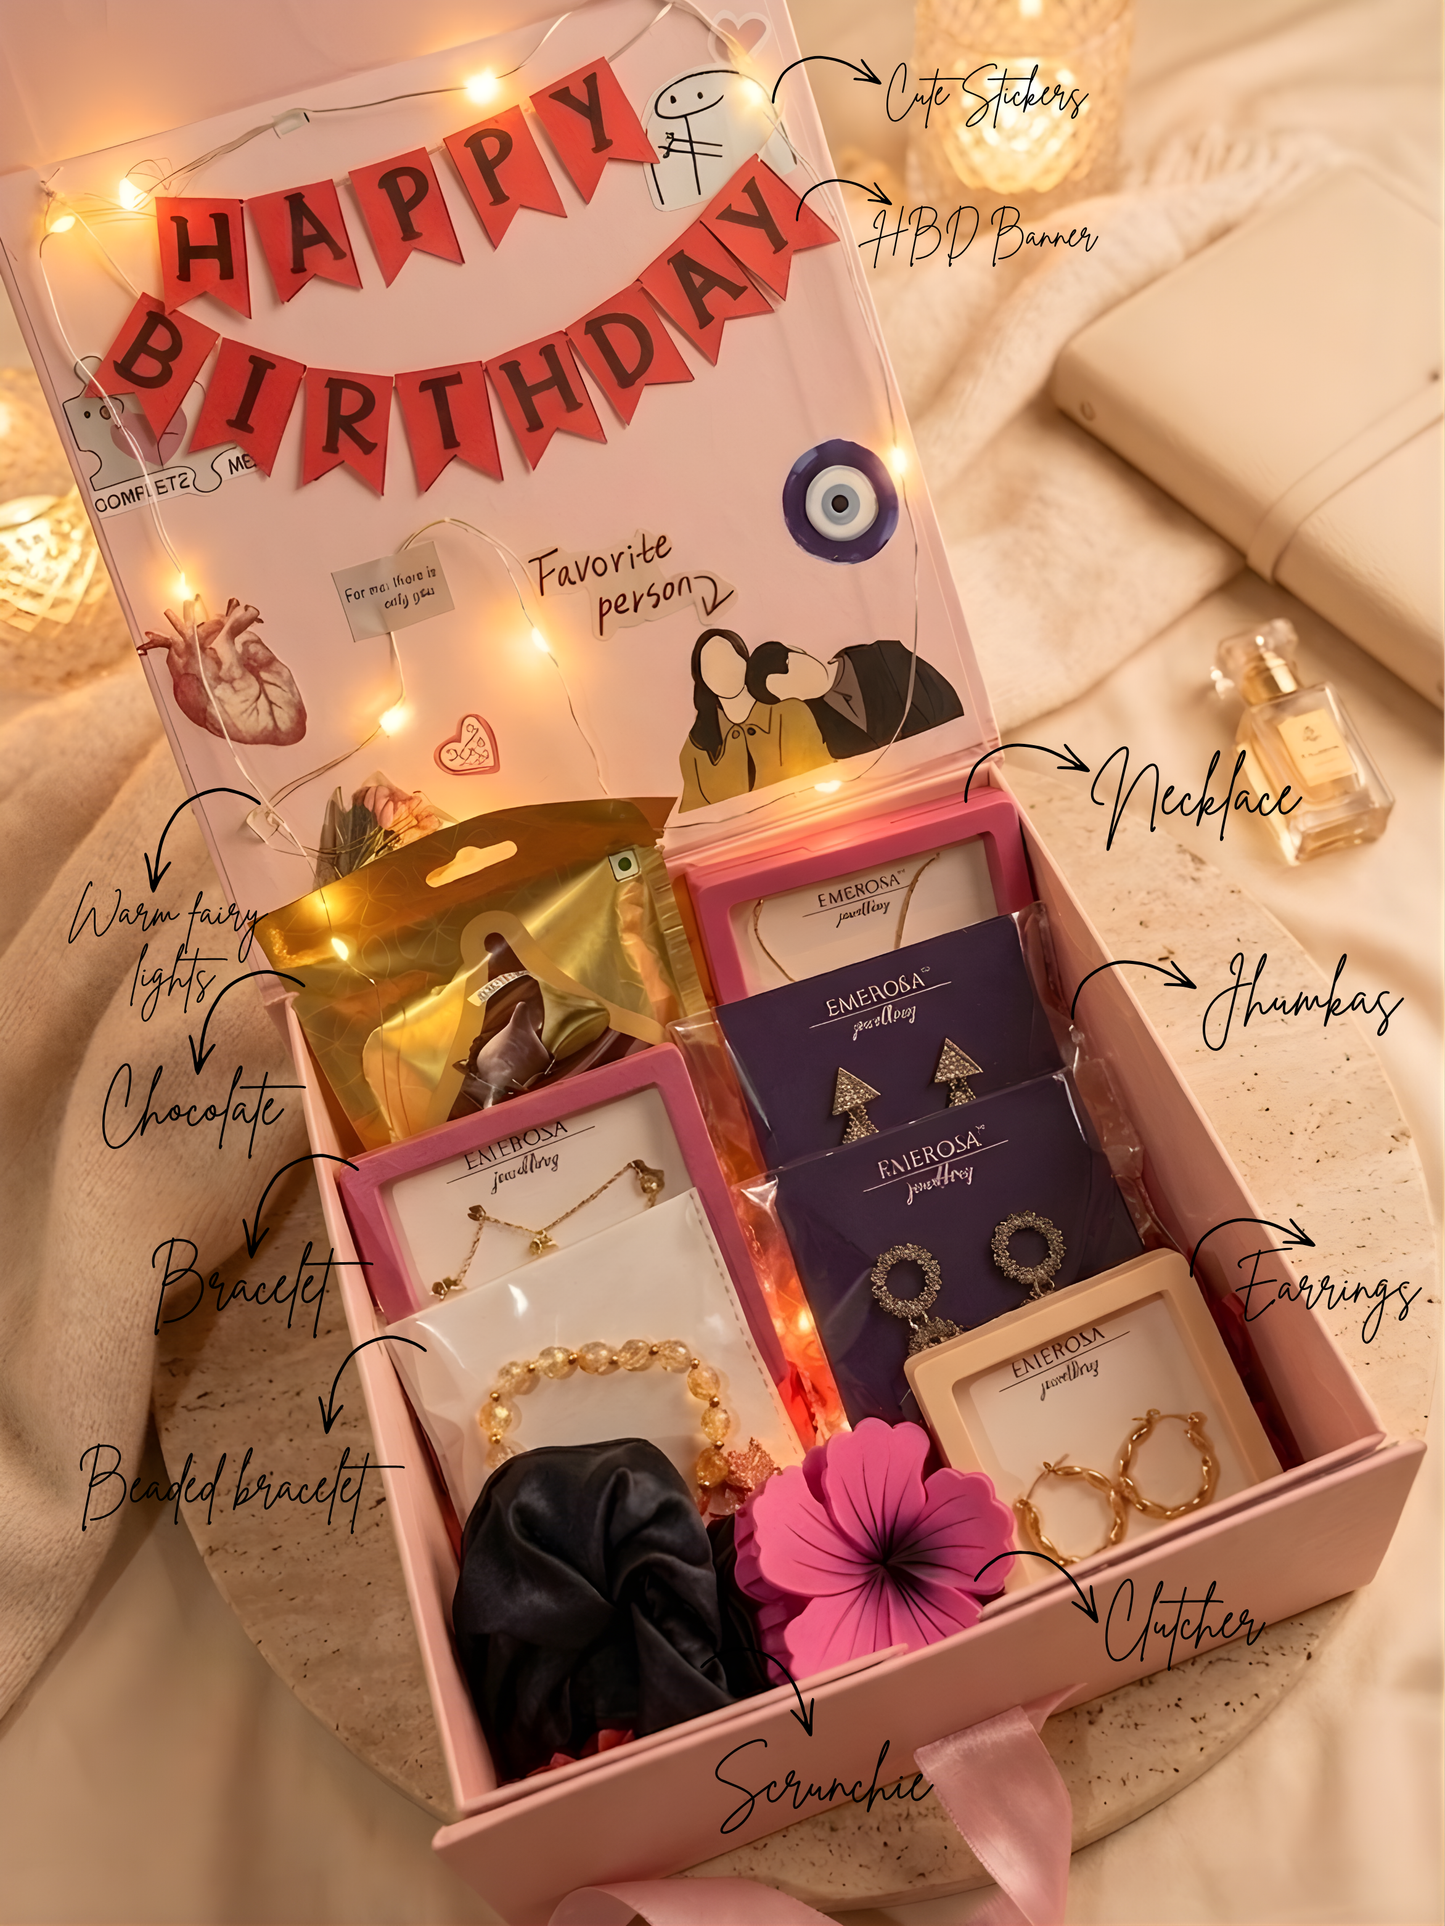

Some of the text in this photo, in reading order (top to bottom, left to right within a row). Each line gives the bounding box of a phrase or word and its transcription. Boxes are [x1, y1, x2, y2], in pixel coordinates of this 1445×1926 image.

[174, 71, 614, 283] HAPPY
[112, 176, 789, 455] BIRTHDAY
[344, 587, 366, 603] For
[528, 533, 672, 596] Favorite
[598, 576, 693, 636] person
